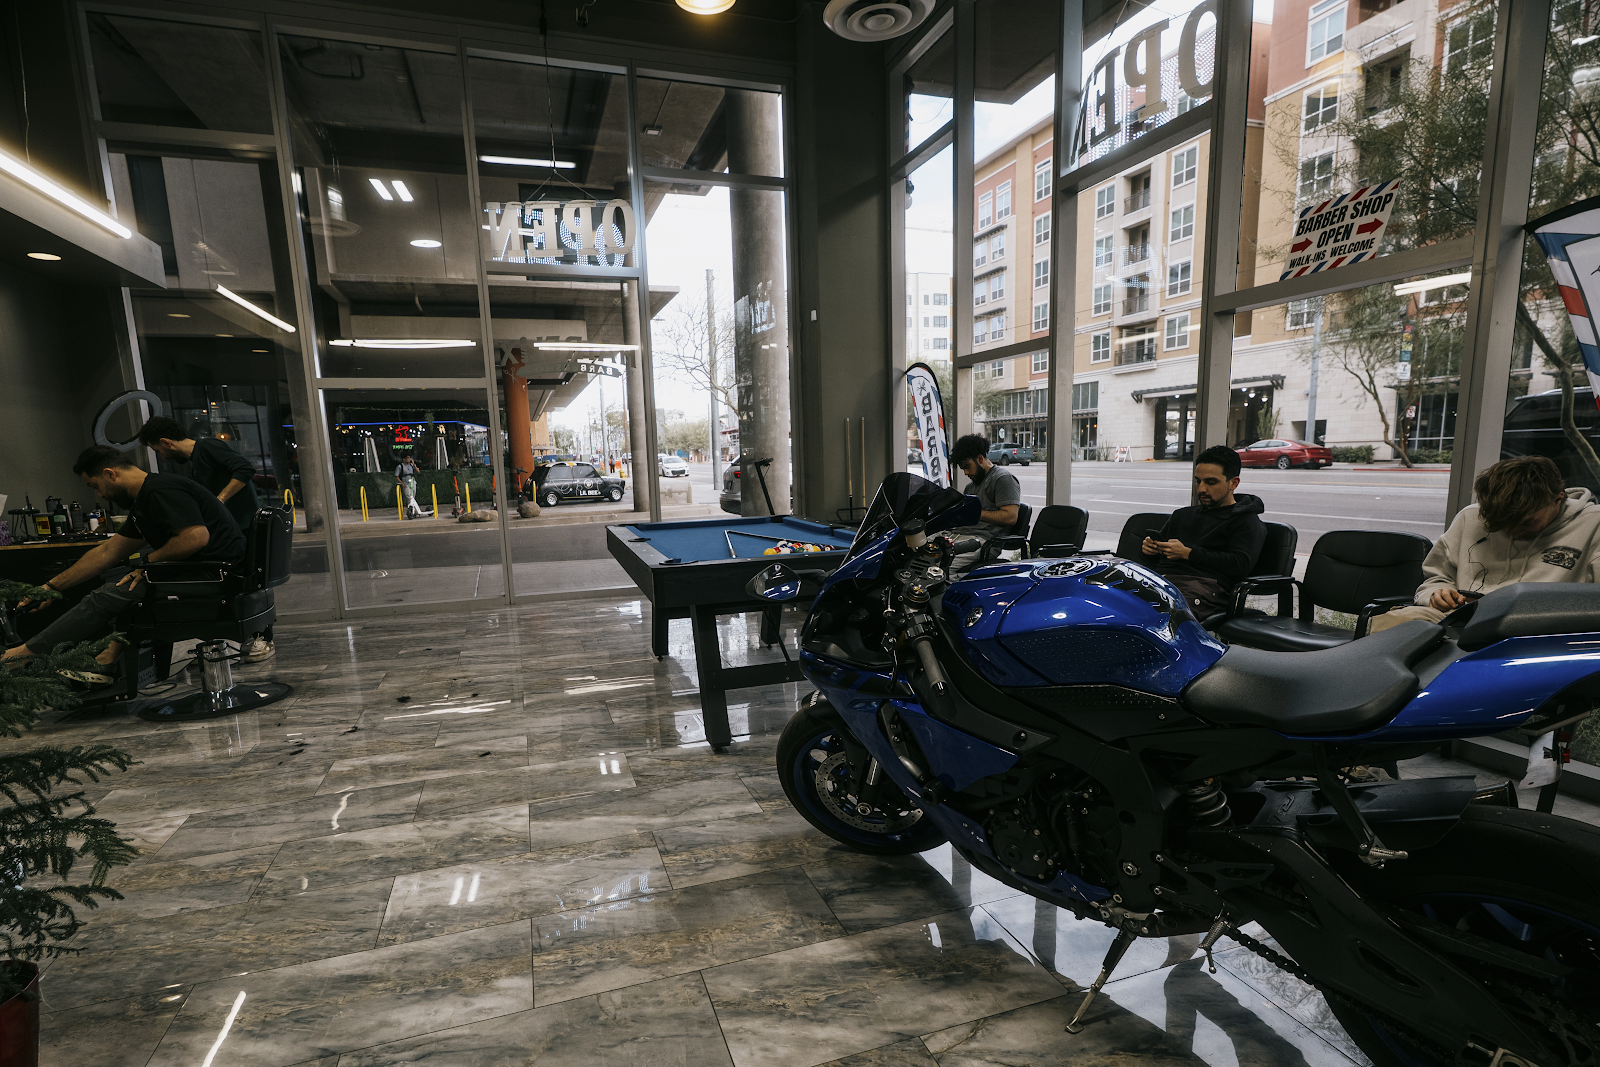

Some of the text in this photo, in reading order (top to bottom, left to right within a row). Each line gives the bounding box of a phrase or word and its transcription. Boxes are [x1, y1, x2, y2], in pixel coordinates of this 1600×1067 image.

[1295, 192, 1394, 237] BARBER SHOP
[1316, 222, 1354, 249] OPEN
[1288, 237, 1376, 269] WALK-INS WELCOME
